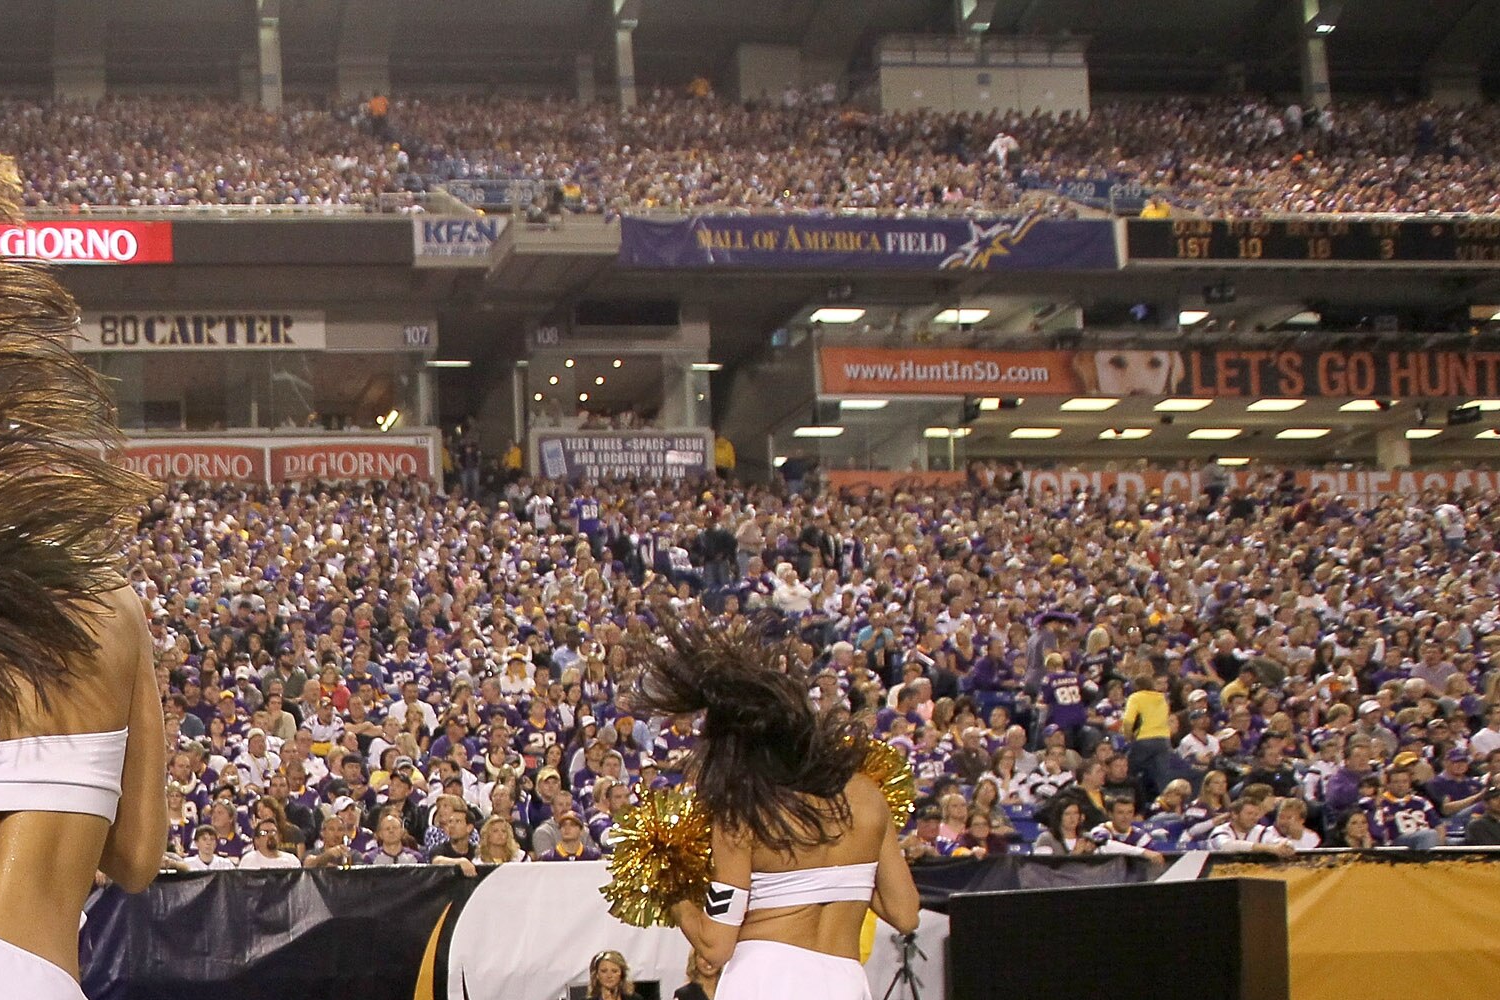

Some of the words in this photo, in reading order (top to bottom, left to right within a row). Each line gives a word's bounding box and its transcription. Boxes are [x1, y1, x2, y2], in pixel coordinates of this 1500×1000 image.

[424, 219, 498, 243] KFAN
[753, 230, 778, 249] OF
[784, 225, 881, 251] AMERICA
[886, 232, 947, 254] FIELD
[1240, 238, 1262, 258] 10
[100, 315, 140, 345] 80
[144, 314, 294, 345] CARTER
[405, 326, 428, 344] 107
[1191, 351, 1304, 396] LET'S
[1318, 351, 1376, 397] GO
[283, 450, 418, 480] DIGIORNO
[597, 451, 649, 464] LOCATION
